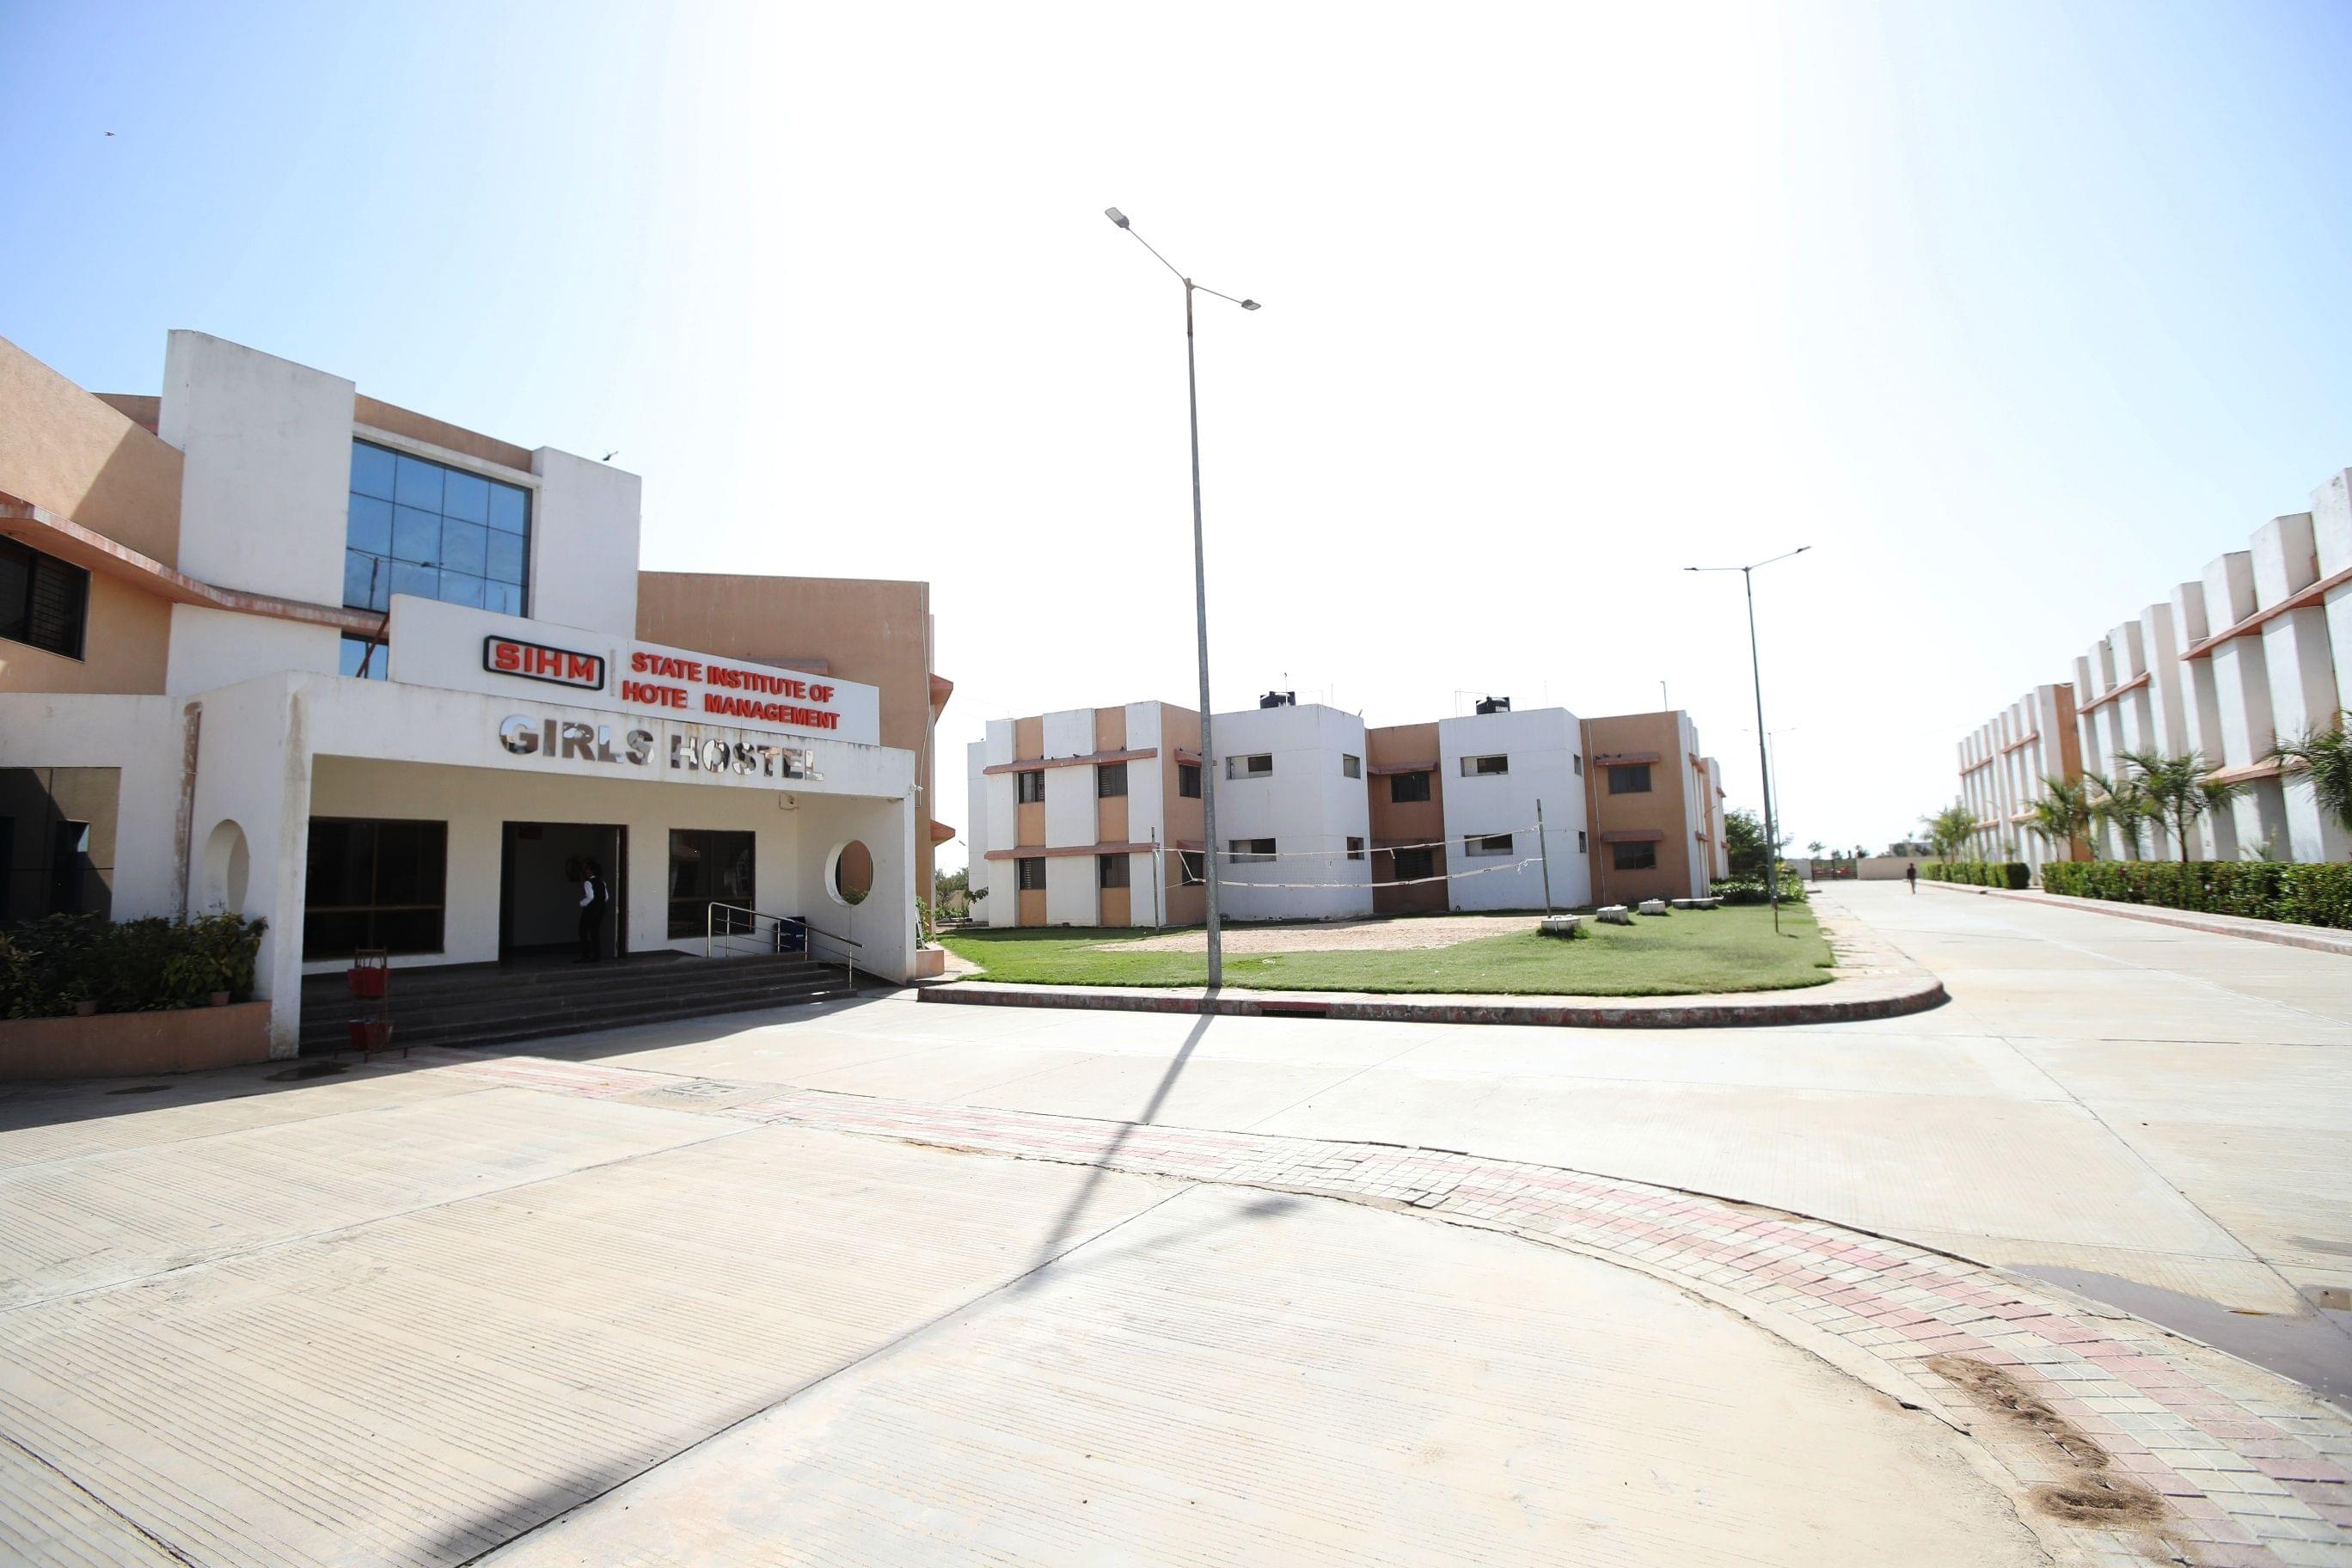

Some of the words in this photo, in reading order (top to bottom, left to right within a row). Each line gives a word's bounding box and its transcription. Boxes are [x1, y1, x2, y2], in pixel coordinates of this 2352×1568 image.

[496, 643, 595, 681] SIHM
[631, 652, 702, 682] STATE
[707, 665, 805, 701] INSTITUTE
[809, 684, 836, 702] OF
[705, 694, 840, 730] MANAGEMENT
[499, 715, 654, 765] GIRLS
[671, 734, 824, 781] HOSTEL
